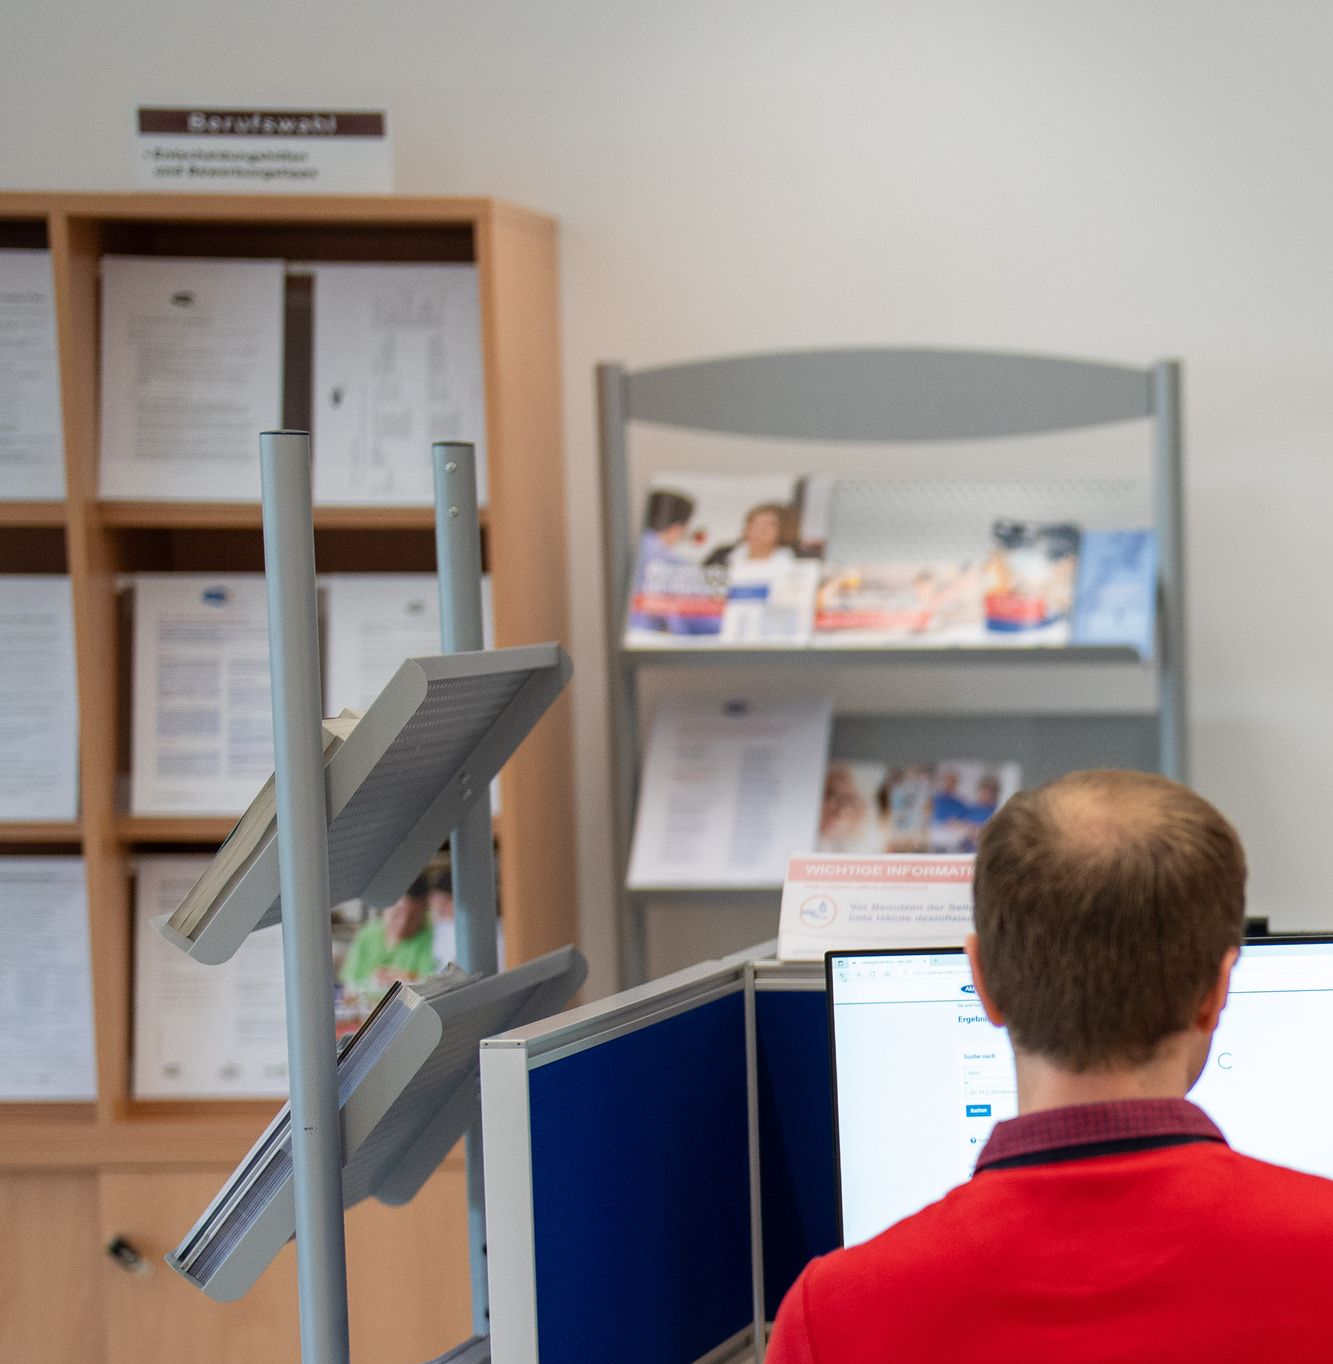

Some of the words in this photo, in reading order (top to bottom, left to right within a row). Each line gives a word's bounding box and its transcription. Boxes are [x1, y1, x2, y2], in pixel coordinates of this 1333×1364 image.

[188, 112, 337, 134] Berufswahl
[806, 864, 882, 876] WICHTIGE
[887, 865, 975, 877] INFORMATI
